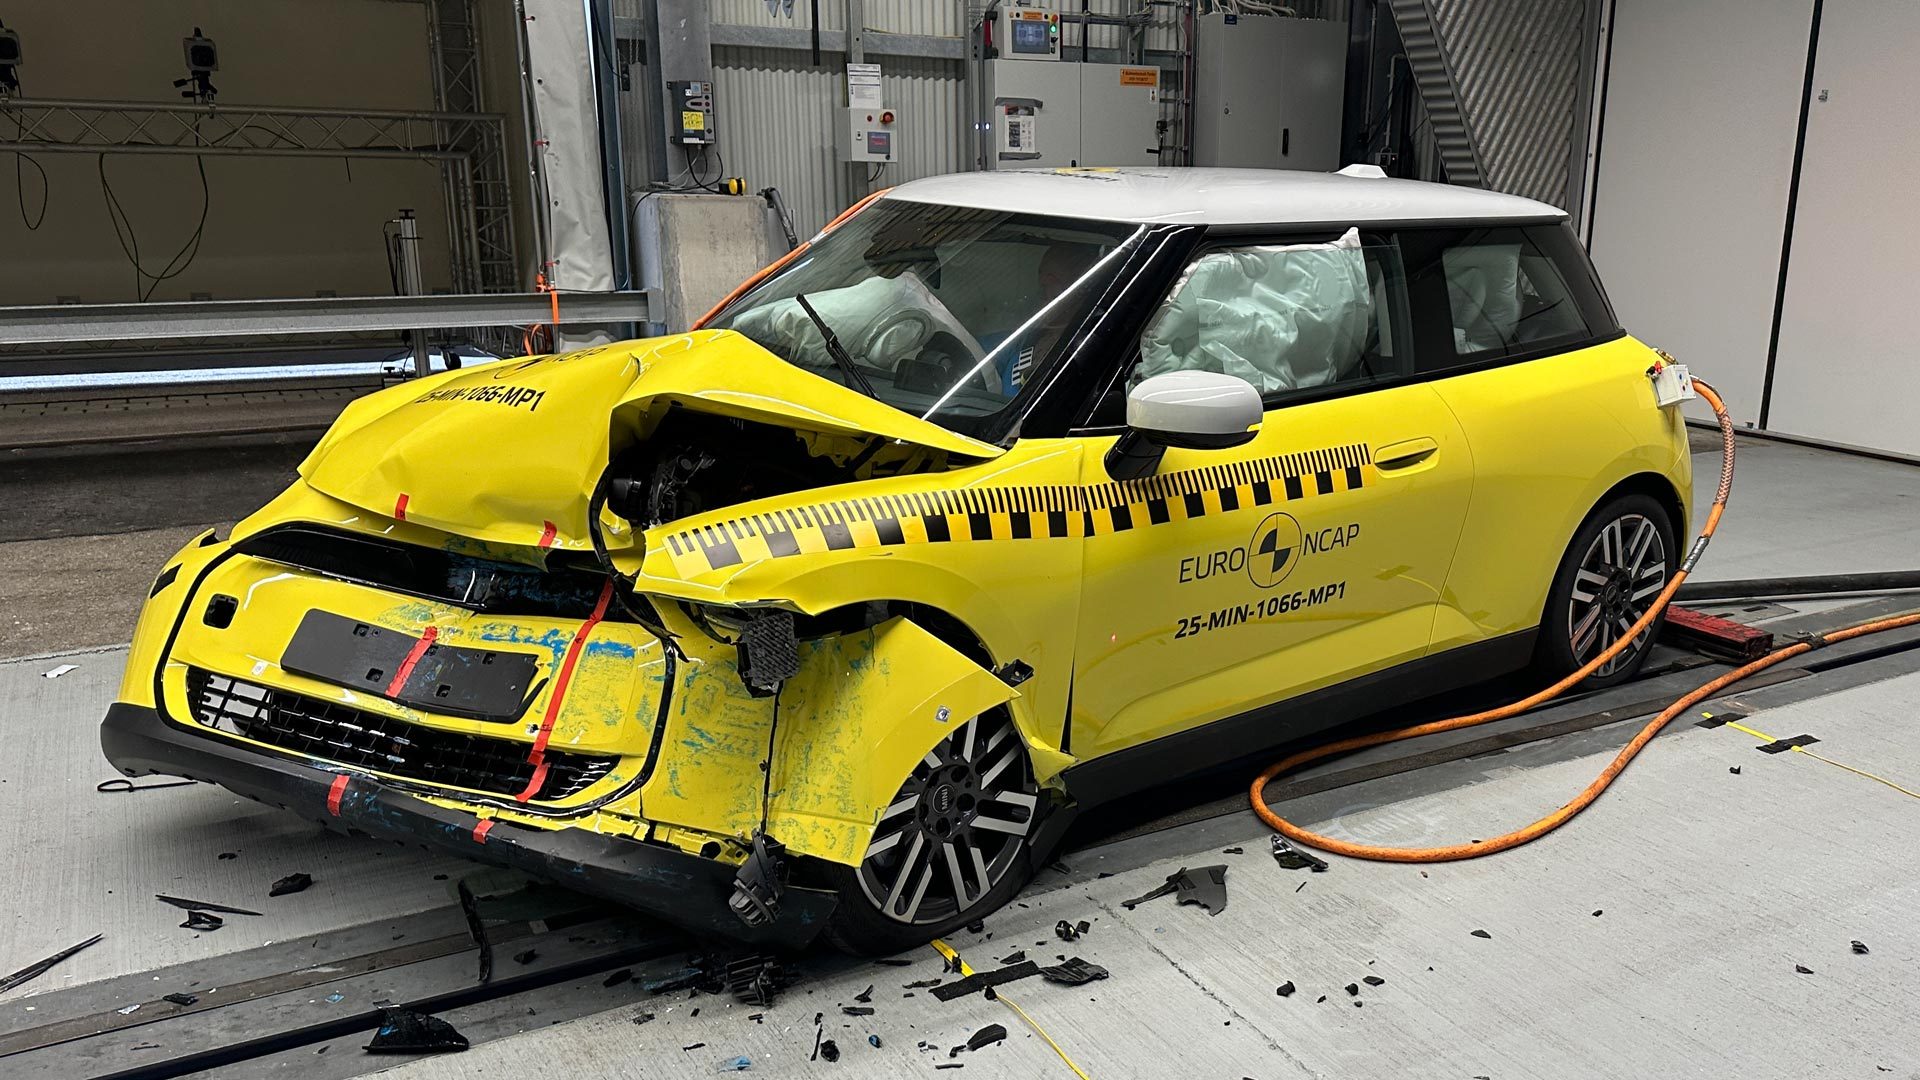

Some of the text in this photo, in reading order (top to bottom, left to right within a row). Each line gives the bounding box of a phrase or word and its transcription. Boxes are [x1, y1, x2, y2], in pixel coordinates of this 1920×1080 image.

[1178, 523, 1359, 584] EURO NCAP
[1174, 581, 1346, 639] 25-MIN-1066-MP1
